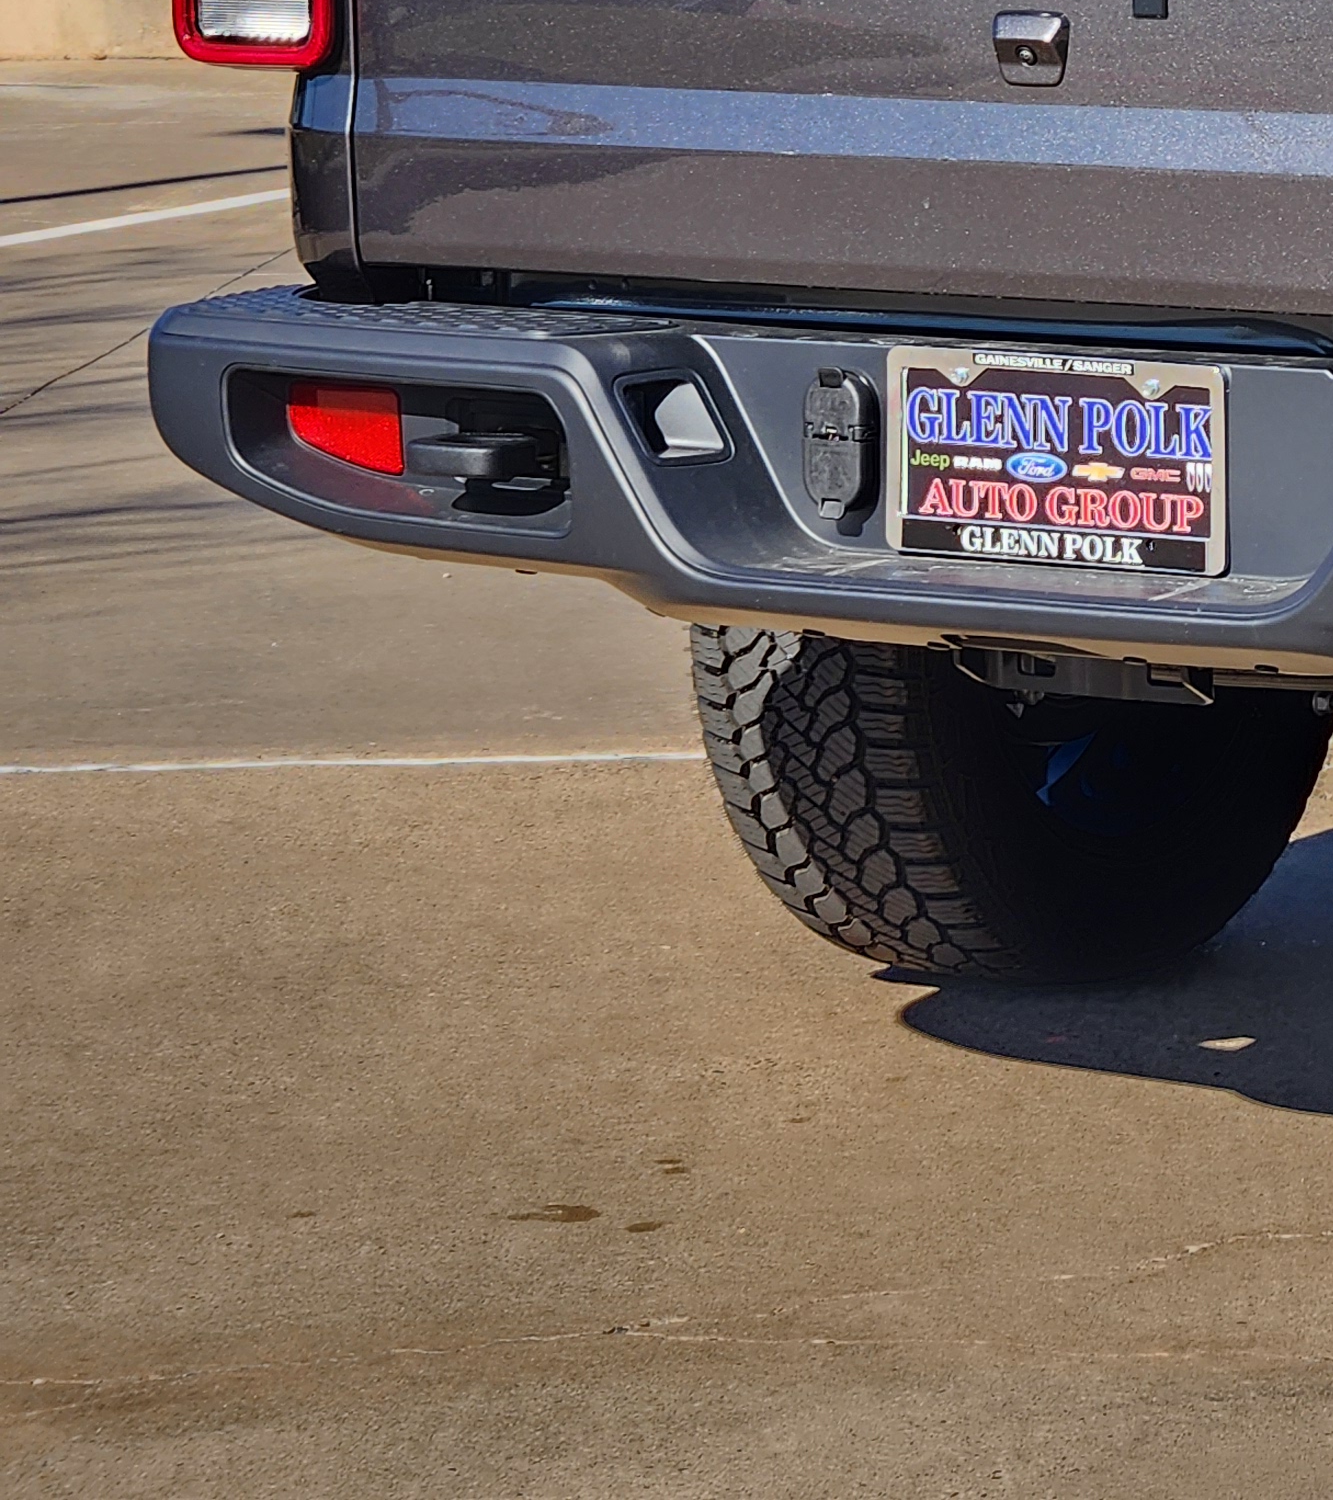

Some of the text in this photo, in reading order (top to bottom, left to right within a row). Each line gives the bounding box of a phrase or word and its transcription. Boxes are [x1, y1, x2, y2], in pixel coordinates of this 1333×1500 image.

[907, 386, 1212, 459] GLENN POLK
[910, 449, 1181, 483] Jeep RAM Ford GMC
[919, 477, 1204, 533] AUTO GROUP
[960, 526, 1143, 566] GLENN POLK
